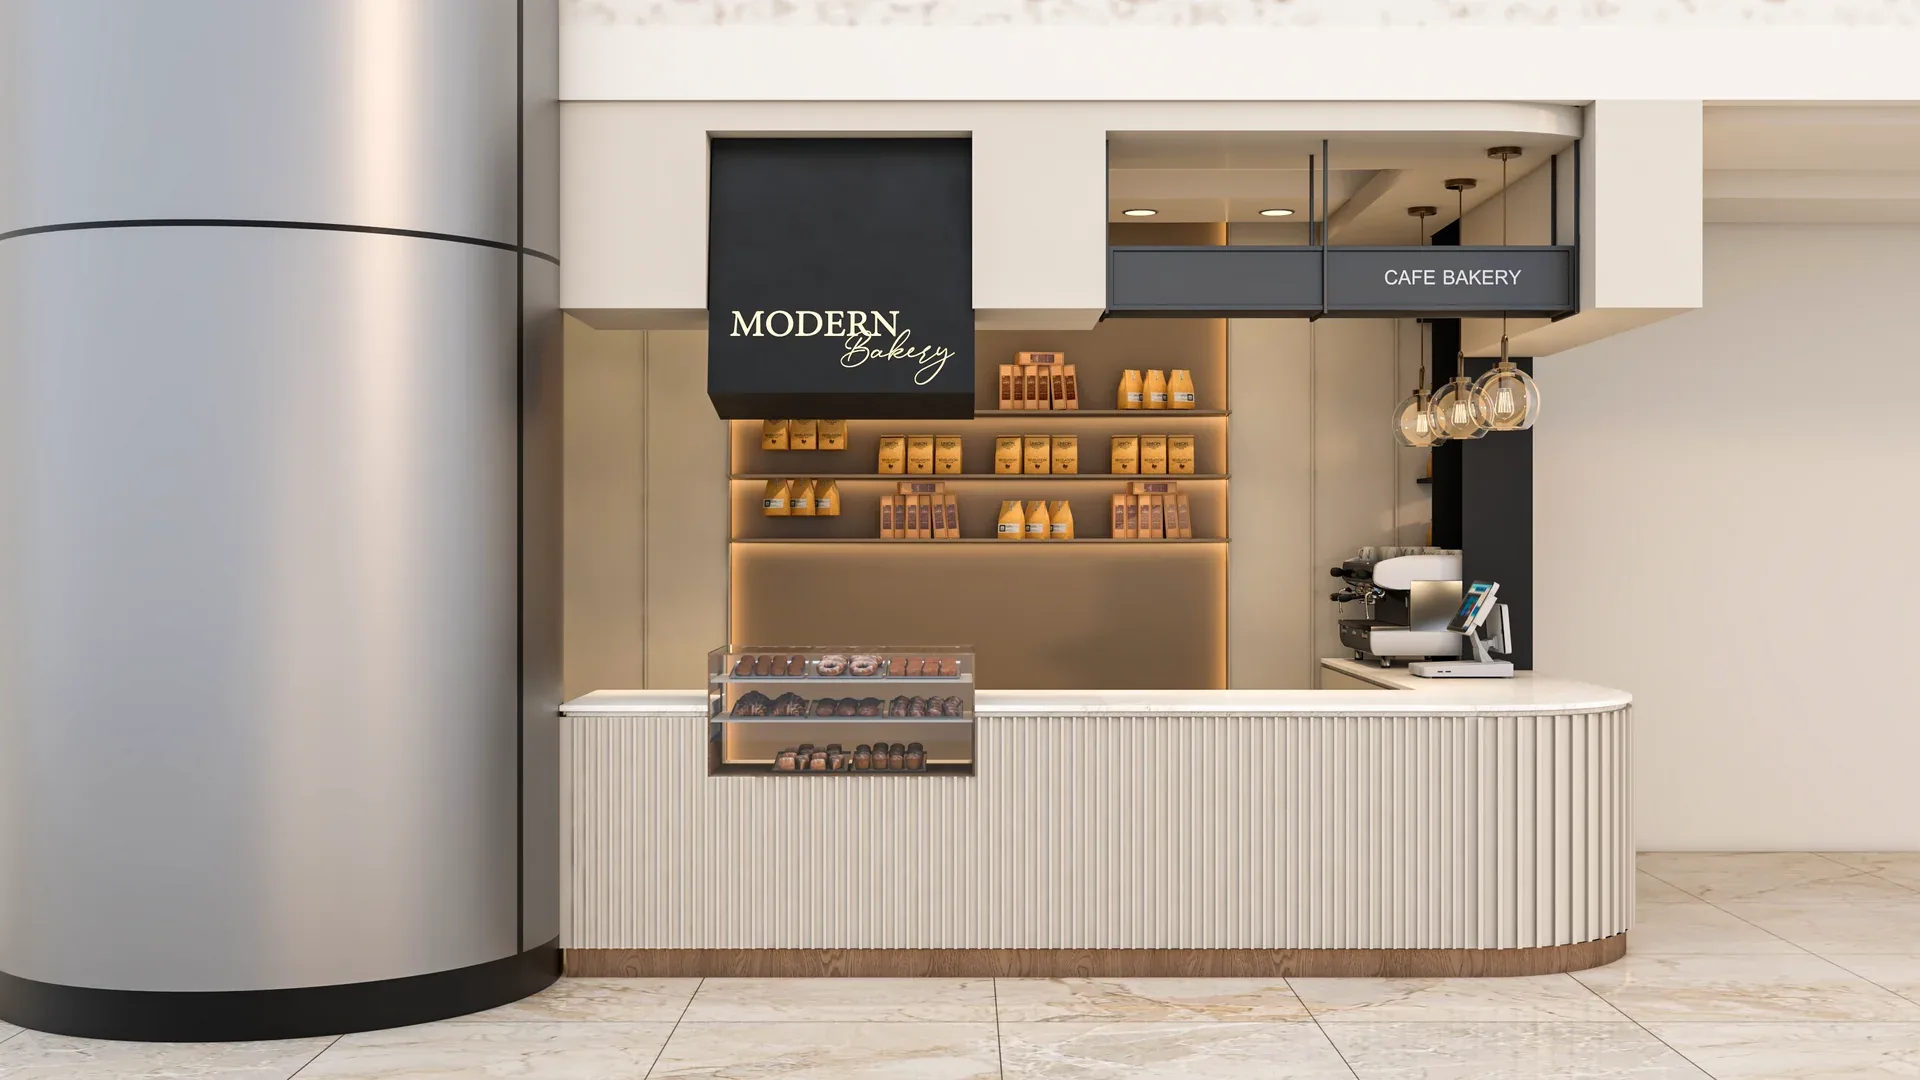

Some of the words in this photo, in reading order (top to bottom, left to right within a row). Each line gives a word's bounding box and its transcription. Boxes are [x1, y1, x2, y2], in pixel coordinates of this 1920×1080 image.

[1384, 269, 1436, 286] CAFE
[1443, 269, 1522, 286] BAKERY
[730, 310, 900, 338] MODERN
[840, 329, 956, 386] Bakery
